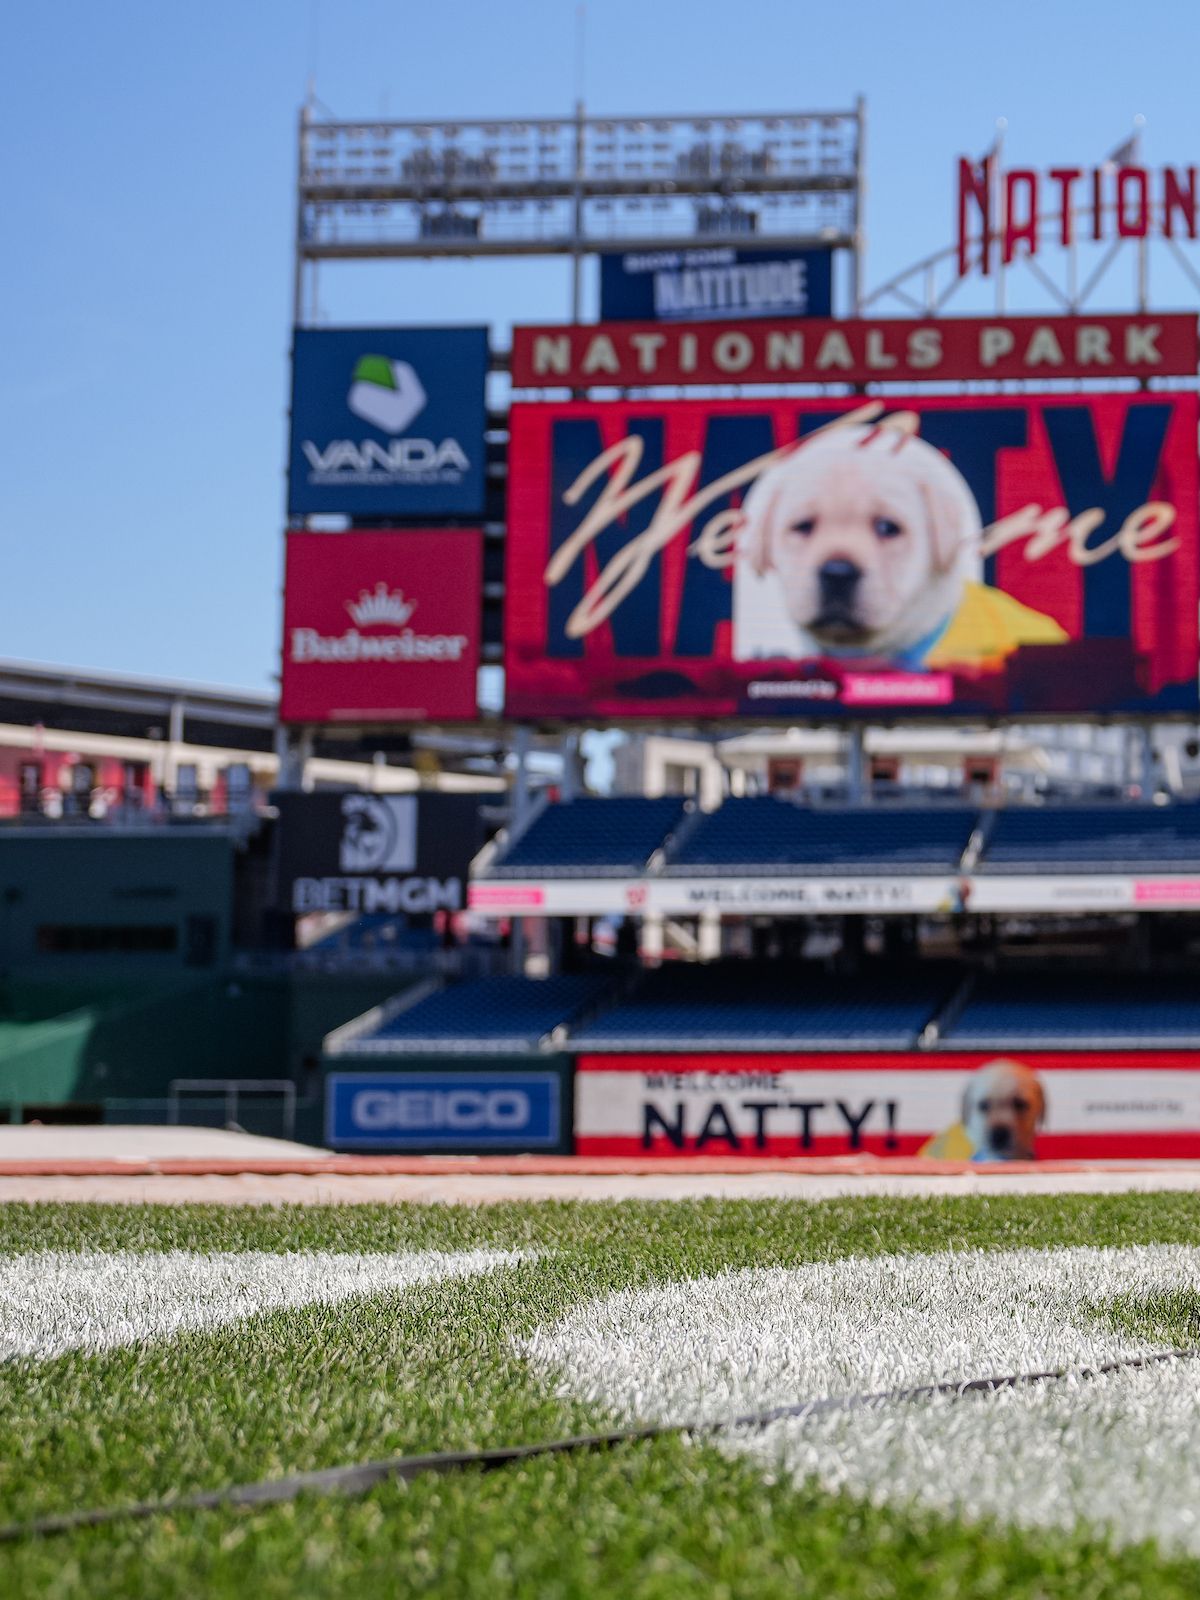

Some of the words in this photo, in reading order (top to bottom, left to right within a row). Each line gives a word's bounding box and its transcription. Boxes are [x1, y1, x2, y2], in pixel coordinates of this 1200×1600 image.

[533, 327, 944, 375] NATIONALS
[978, 323, 1164, 368] PARK
[301, 437, 471, 472] VANDA
[291, 627, 468, 663] Budweiser
[292, 877, 461, 912] BETMGM
[352, 1089, 530, 1128] GEICO
[642, 1100, 898, 1150] NATTY!
